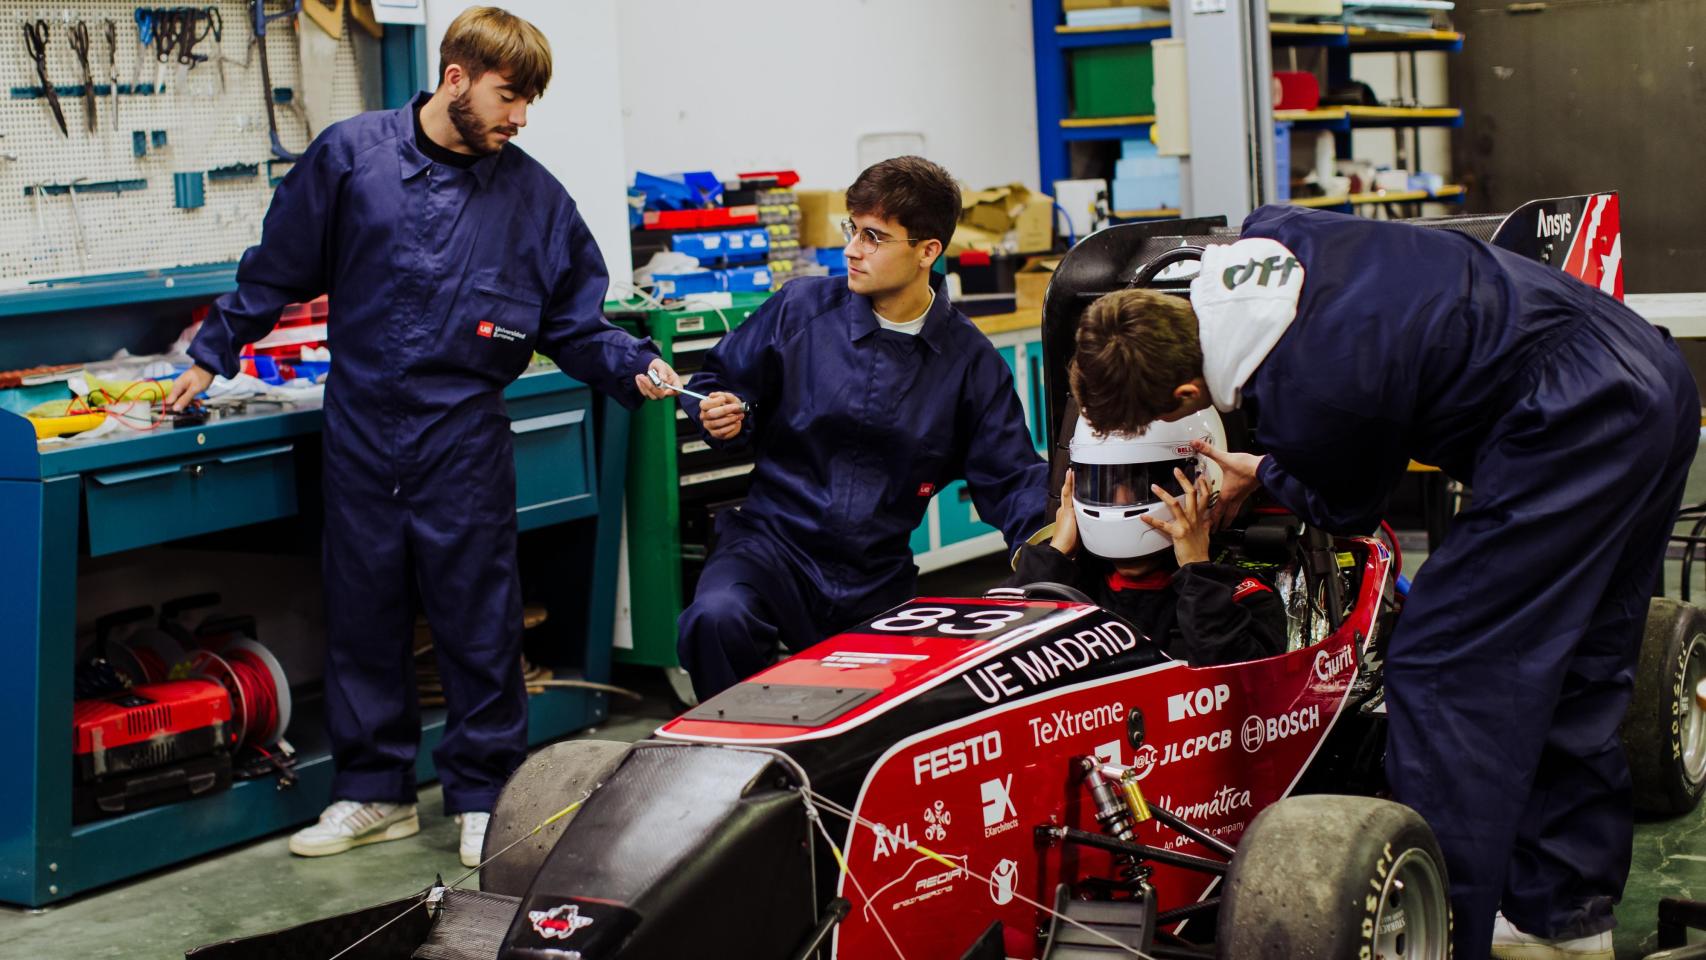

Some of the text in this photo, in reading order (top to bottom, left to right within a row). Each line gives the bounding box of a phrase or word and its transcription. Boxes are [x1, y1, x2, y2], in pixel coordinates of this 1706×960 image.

[1537, 208, 1572, 241] Ansys
[870, 607, 1024, 635] 83
[962, 621, 1136, 704] UE MADRID
[1315, 644, 1354, 682] Gurit
[1167, 684, 1231, 723] KOP
[1028, 701, 1124, 747] TeXtreme
[1266, 704, 1320, 742] BOSCH
[913, 730, 1003, 786] FESTO
[1159, 729, 1233, 767] JLCPCB
[872, 823, 918, 862] AVL
